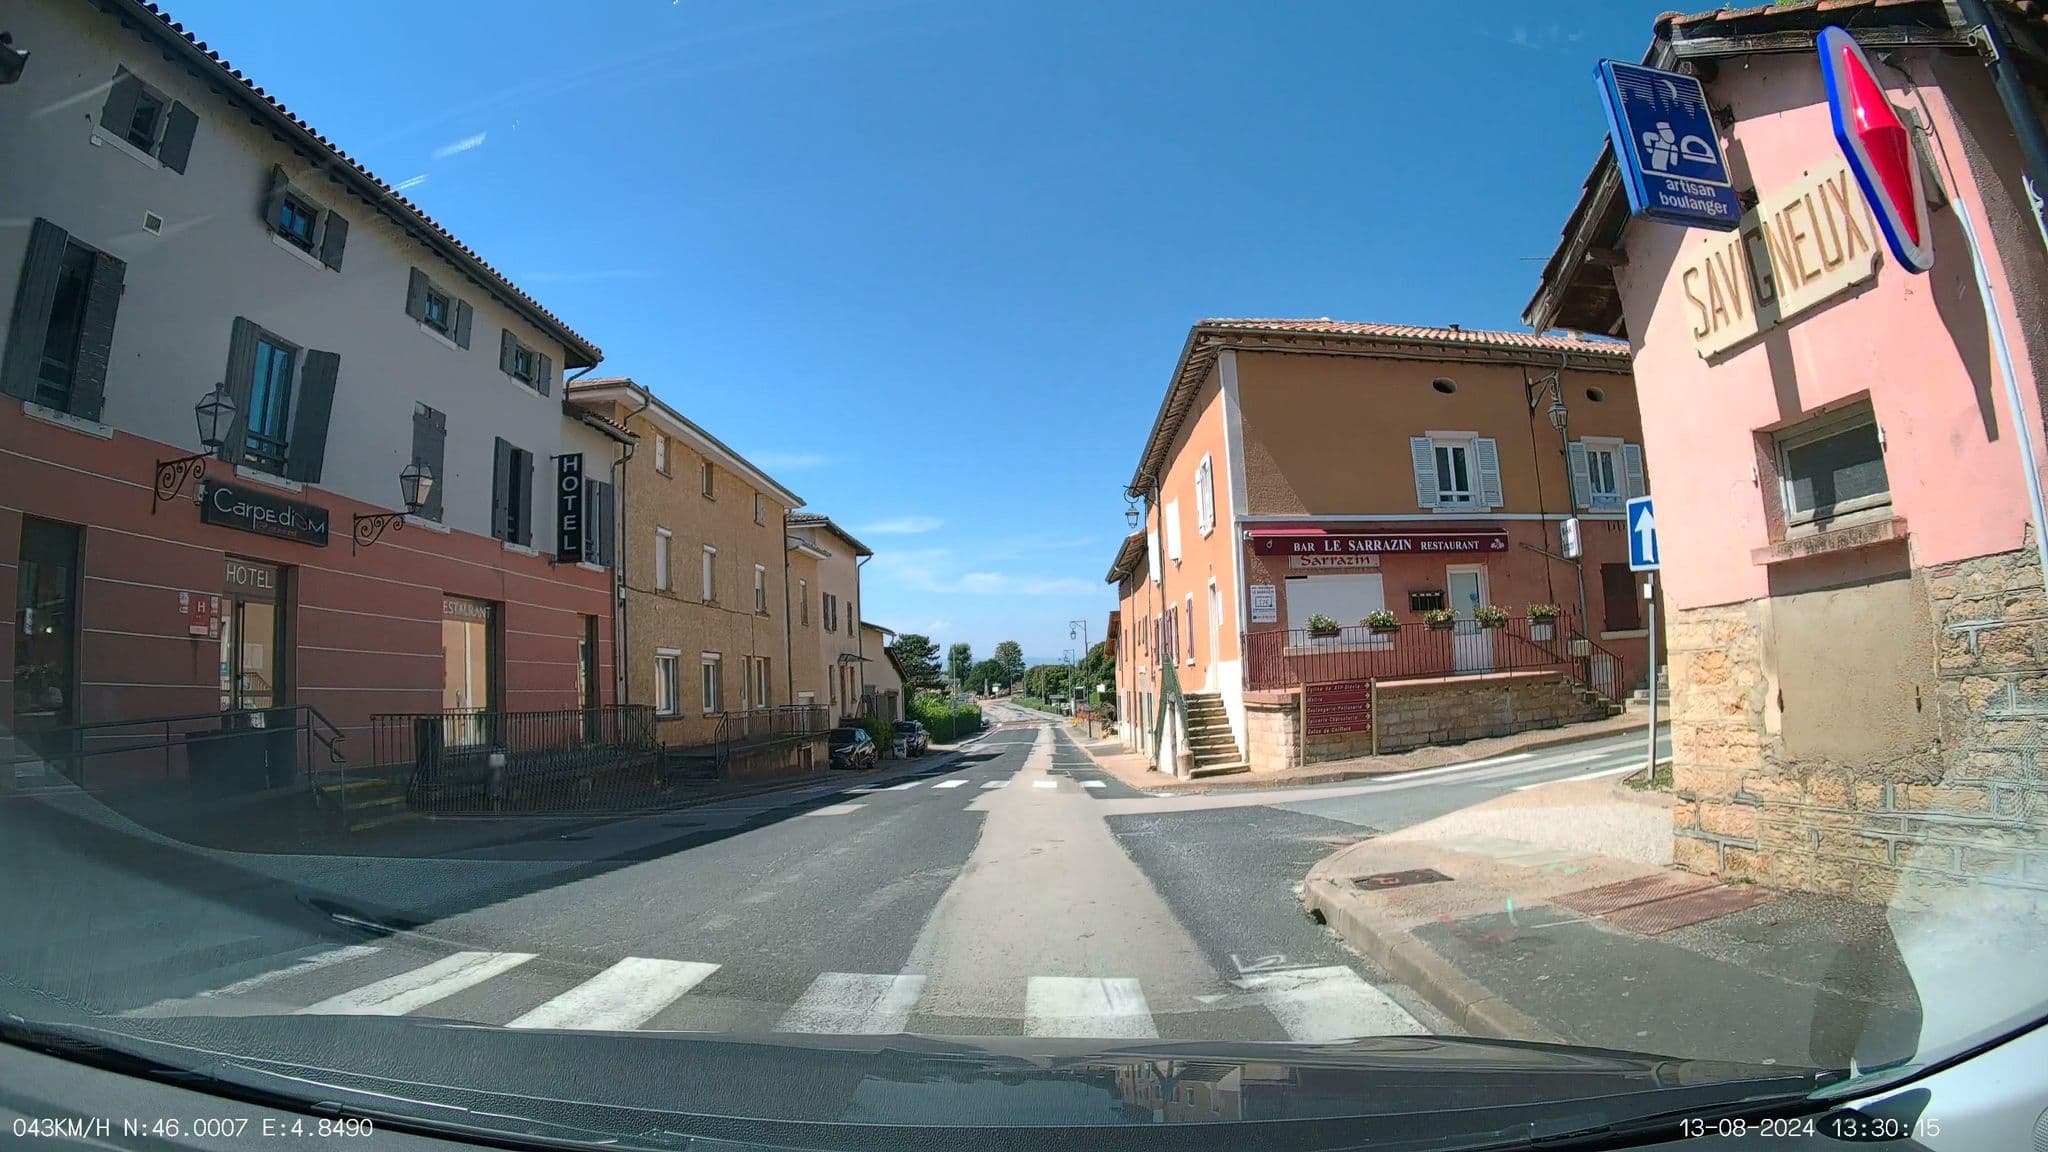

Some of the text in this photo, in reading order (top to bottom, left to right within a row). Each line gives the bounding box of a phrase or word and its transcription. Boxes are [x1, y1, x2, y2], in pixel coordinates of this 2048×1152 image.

[1665, 179, 1716, 197] artisan
[1658, 191, 1728, 216] boulanger
[1682, 168, 1870, 341] SAVIGNEUX
[562, 455, 579, 551] HOTEL
[1293, 538, 1480, 552] BAR LE SARRAZIN RESTAURANT
[1301, 554, 1370, 566] Sarrazin
[226, 563, 273, 589] HOTEL
[443, 600, 491, 619] ESTAURANT
